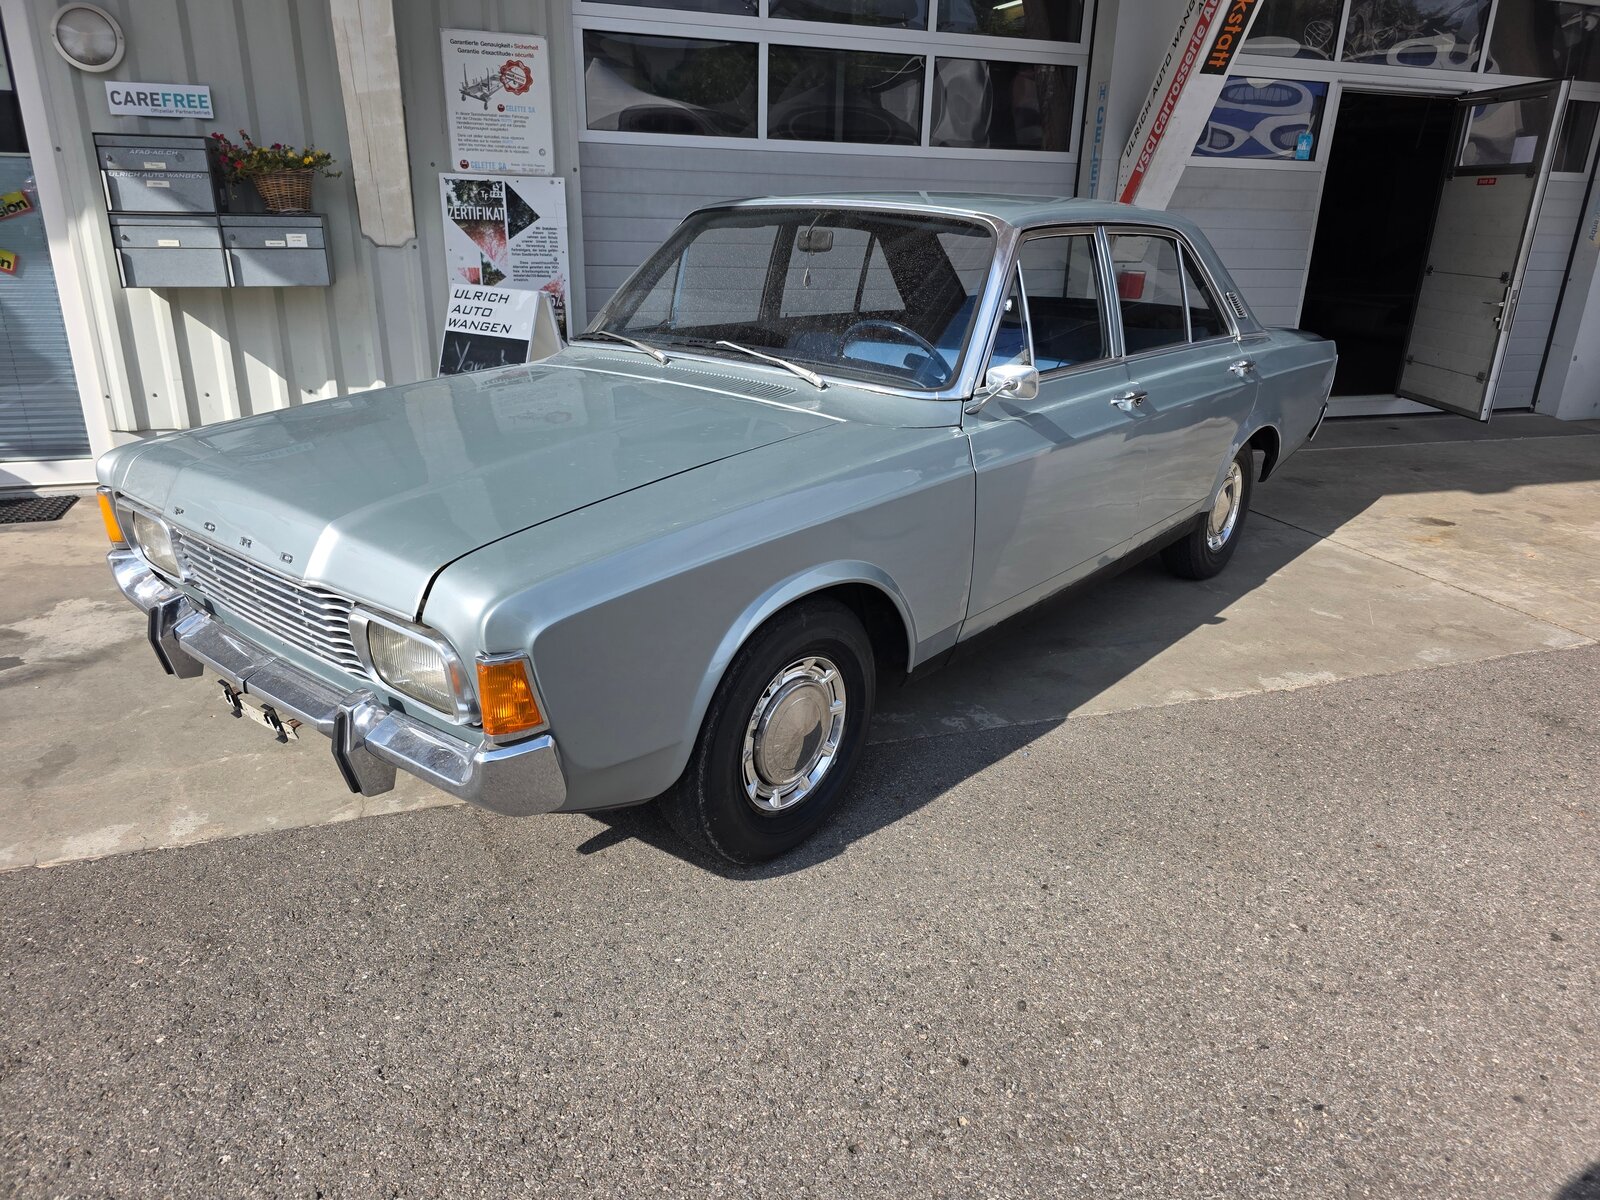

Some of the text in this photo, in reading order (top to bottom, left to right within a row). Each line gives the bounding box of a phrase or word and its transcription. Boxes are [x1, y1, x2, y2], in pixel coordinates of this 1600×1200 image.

[514, 43, 539, 51] Sicherheit
[1155, 24, 1205, 135] Carrosserie
[110, 90, 210, 109] CAREFREE
[1126, 100, 1151, 158] ULRICH
[1152, 54, 1171, 98] AUTO
[448, 206, 504, 221] ZERTIFIKAT
[454, 289, 510, 304] ULRICH
[451, 304, 493, 317] AUTO
[448, 318, 512, 334] WANGEN
[173, 506, 294, 564] FORD
